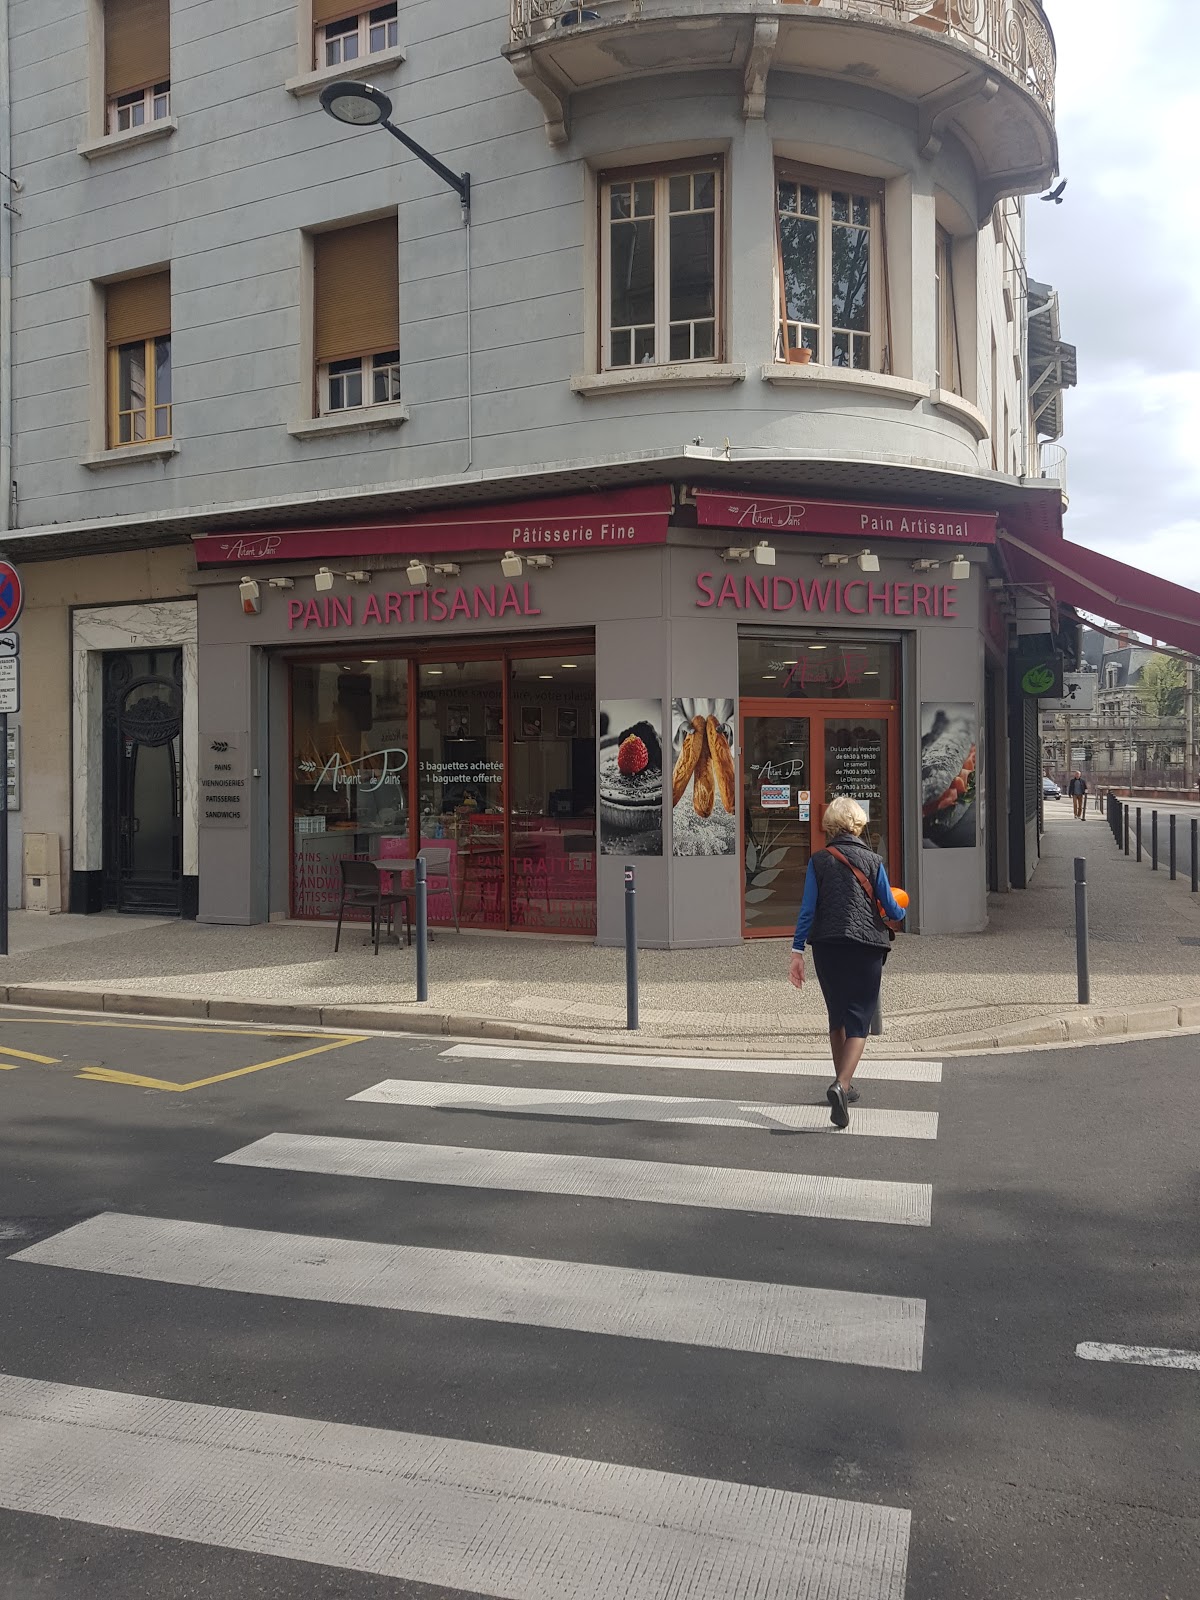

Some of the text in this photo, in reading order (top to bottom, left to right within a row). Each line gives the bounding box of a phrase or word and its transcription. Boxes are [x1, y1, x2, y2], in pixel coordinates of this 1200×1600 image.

[738, 504, 774, 524] Autant
[772, 504, 805, 527] Pains
[512, 524, 635, 543] Pâtisserie Fine
[860, 514, 968, 537] Pain Artisanal
[696, 572, 959, 619] SANDWICHERIE
[287, 581, 542, 630] PAIN ARTISANAL
[313, 752, 362, 792] Autant
[359, 748, 408, 792] Pains
[419, 762, 425, 770] 3
[426, 761, 469, 773] baguettes
[201, 779, 245, 787] VIENNOISERIES
[425, 773, 502, 785] 1 baguette offerte
[205, 795, 240, 803] PATISSERIES
[205, 811, 241, 819] SANDWICHS
